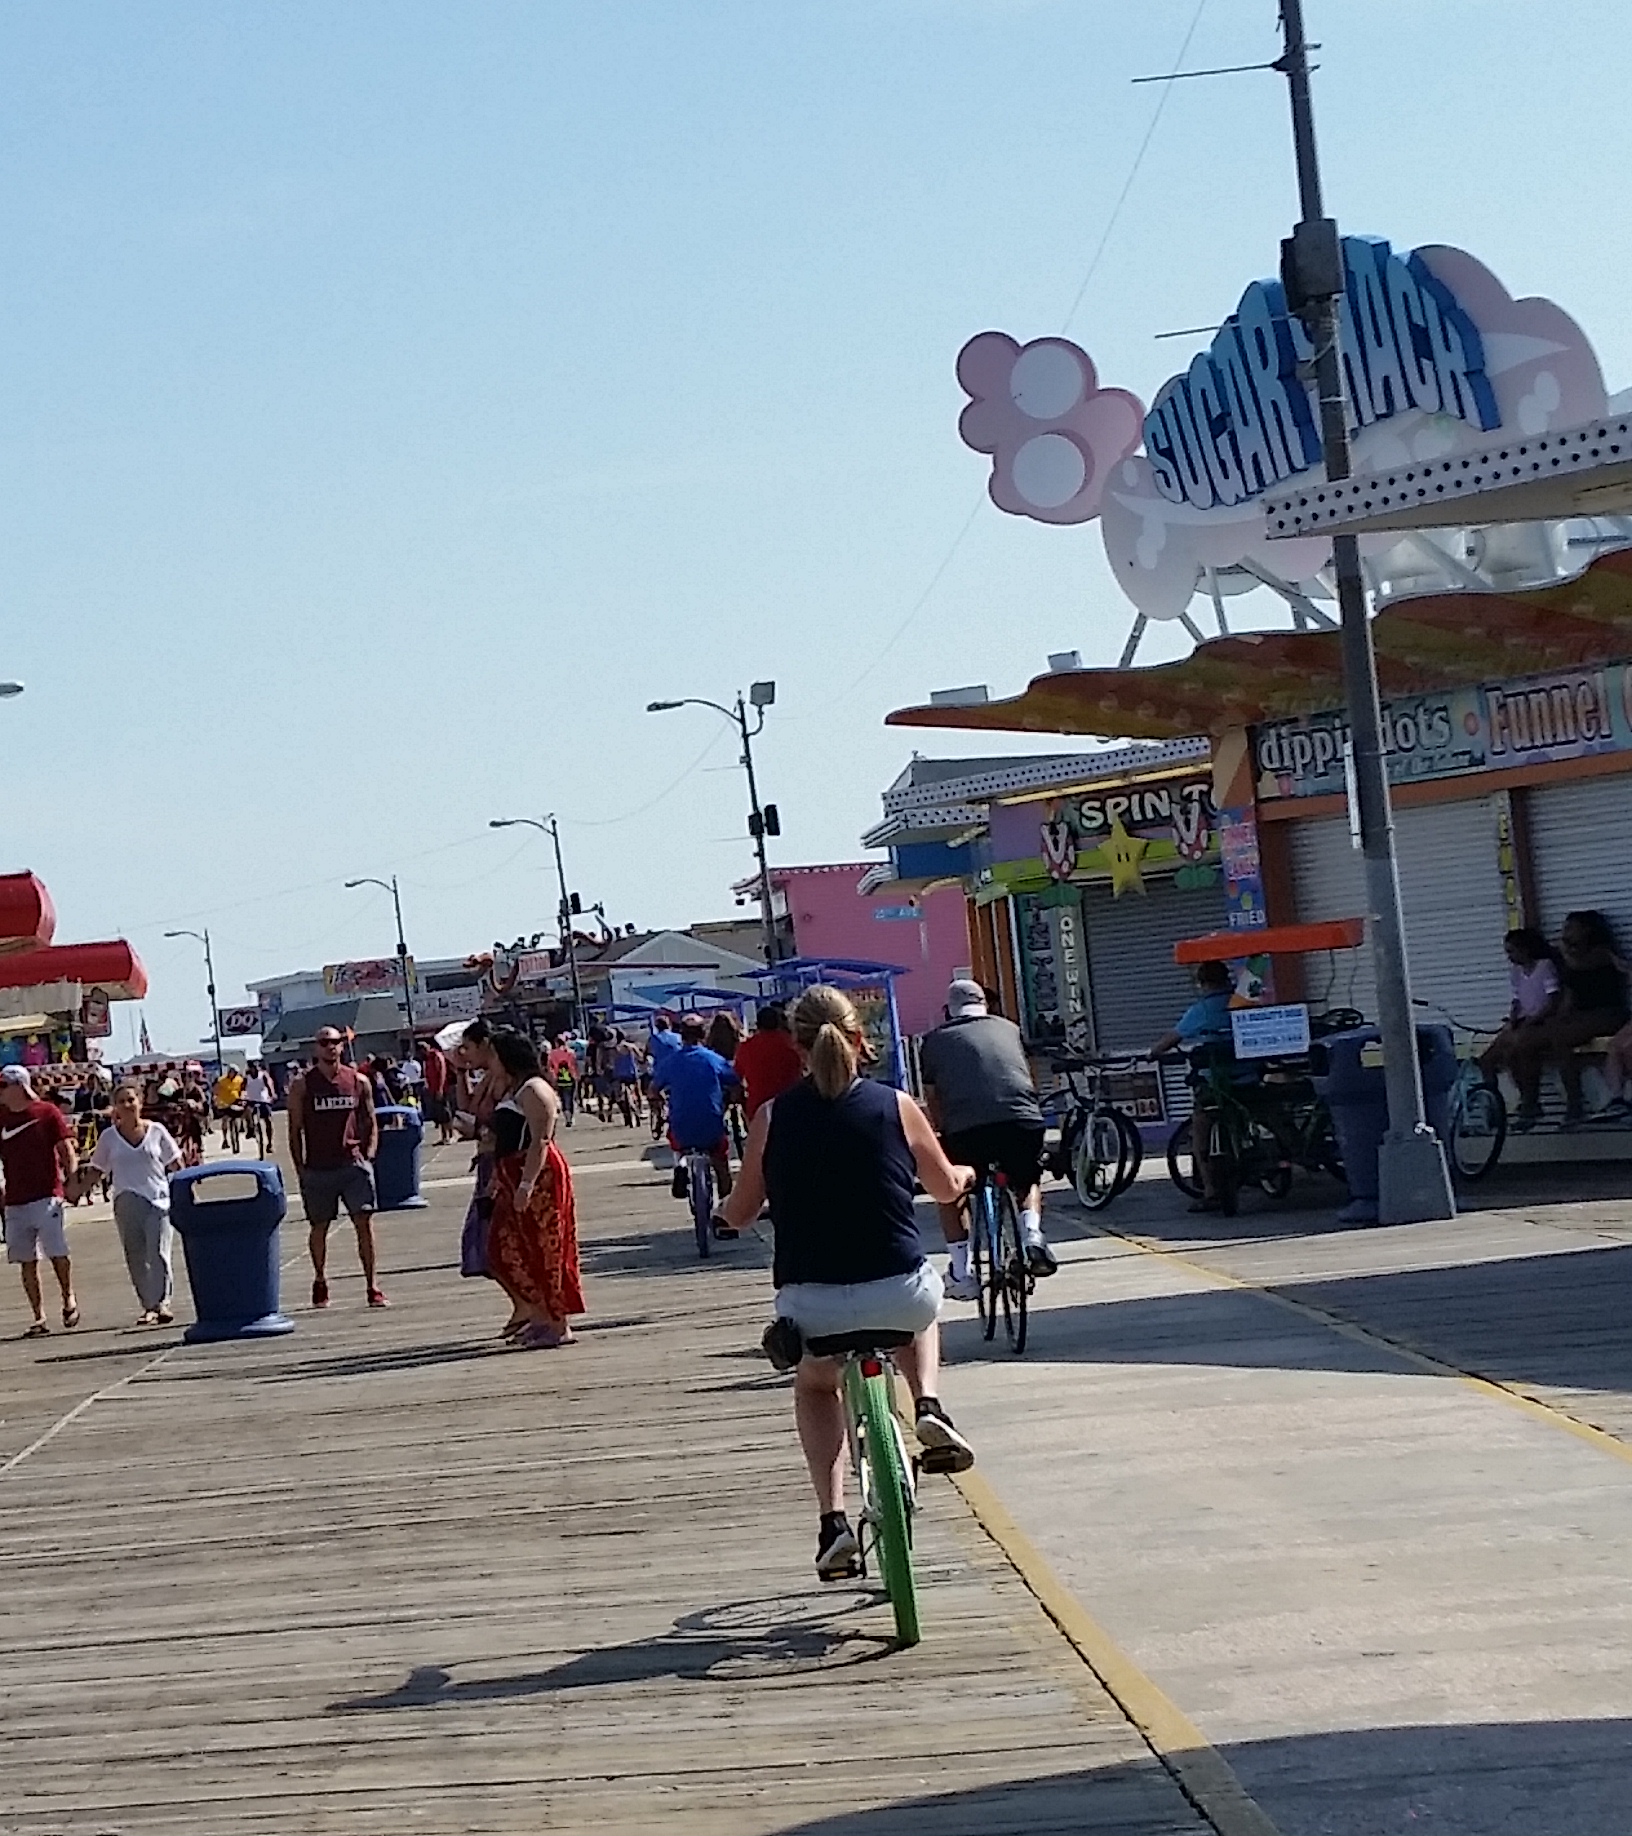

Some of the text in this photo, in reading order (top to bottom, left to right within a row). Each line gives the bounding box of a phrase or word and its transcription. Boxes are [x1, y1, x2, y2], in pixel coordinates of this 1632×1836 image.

[1146, 281, 1306, 509] SUGAR
[1485, 676, 1612, 754] Funnel
[1260, 716, 1352, 778] dippi
[1080, 790, 1173, 830] SPIN
[230, 1014, 255, 1028] DQ
